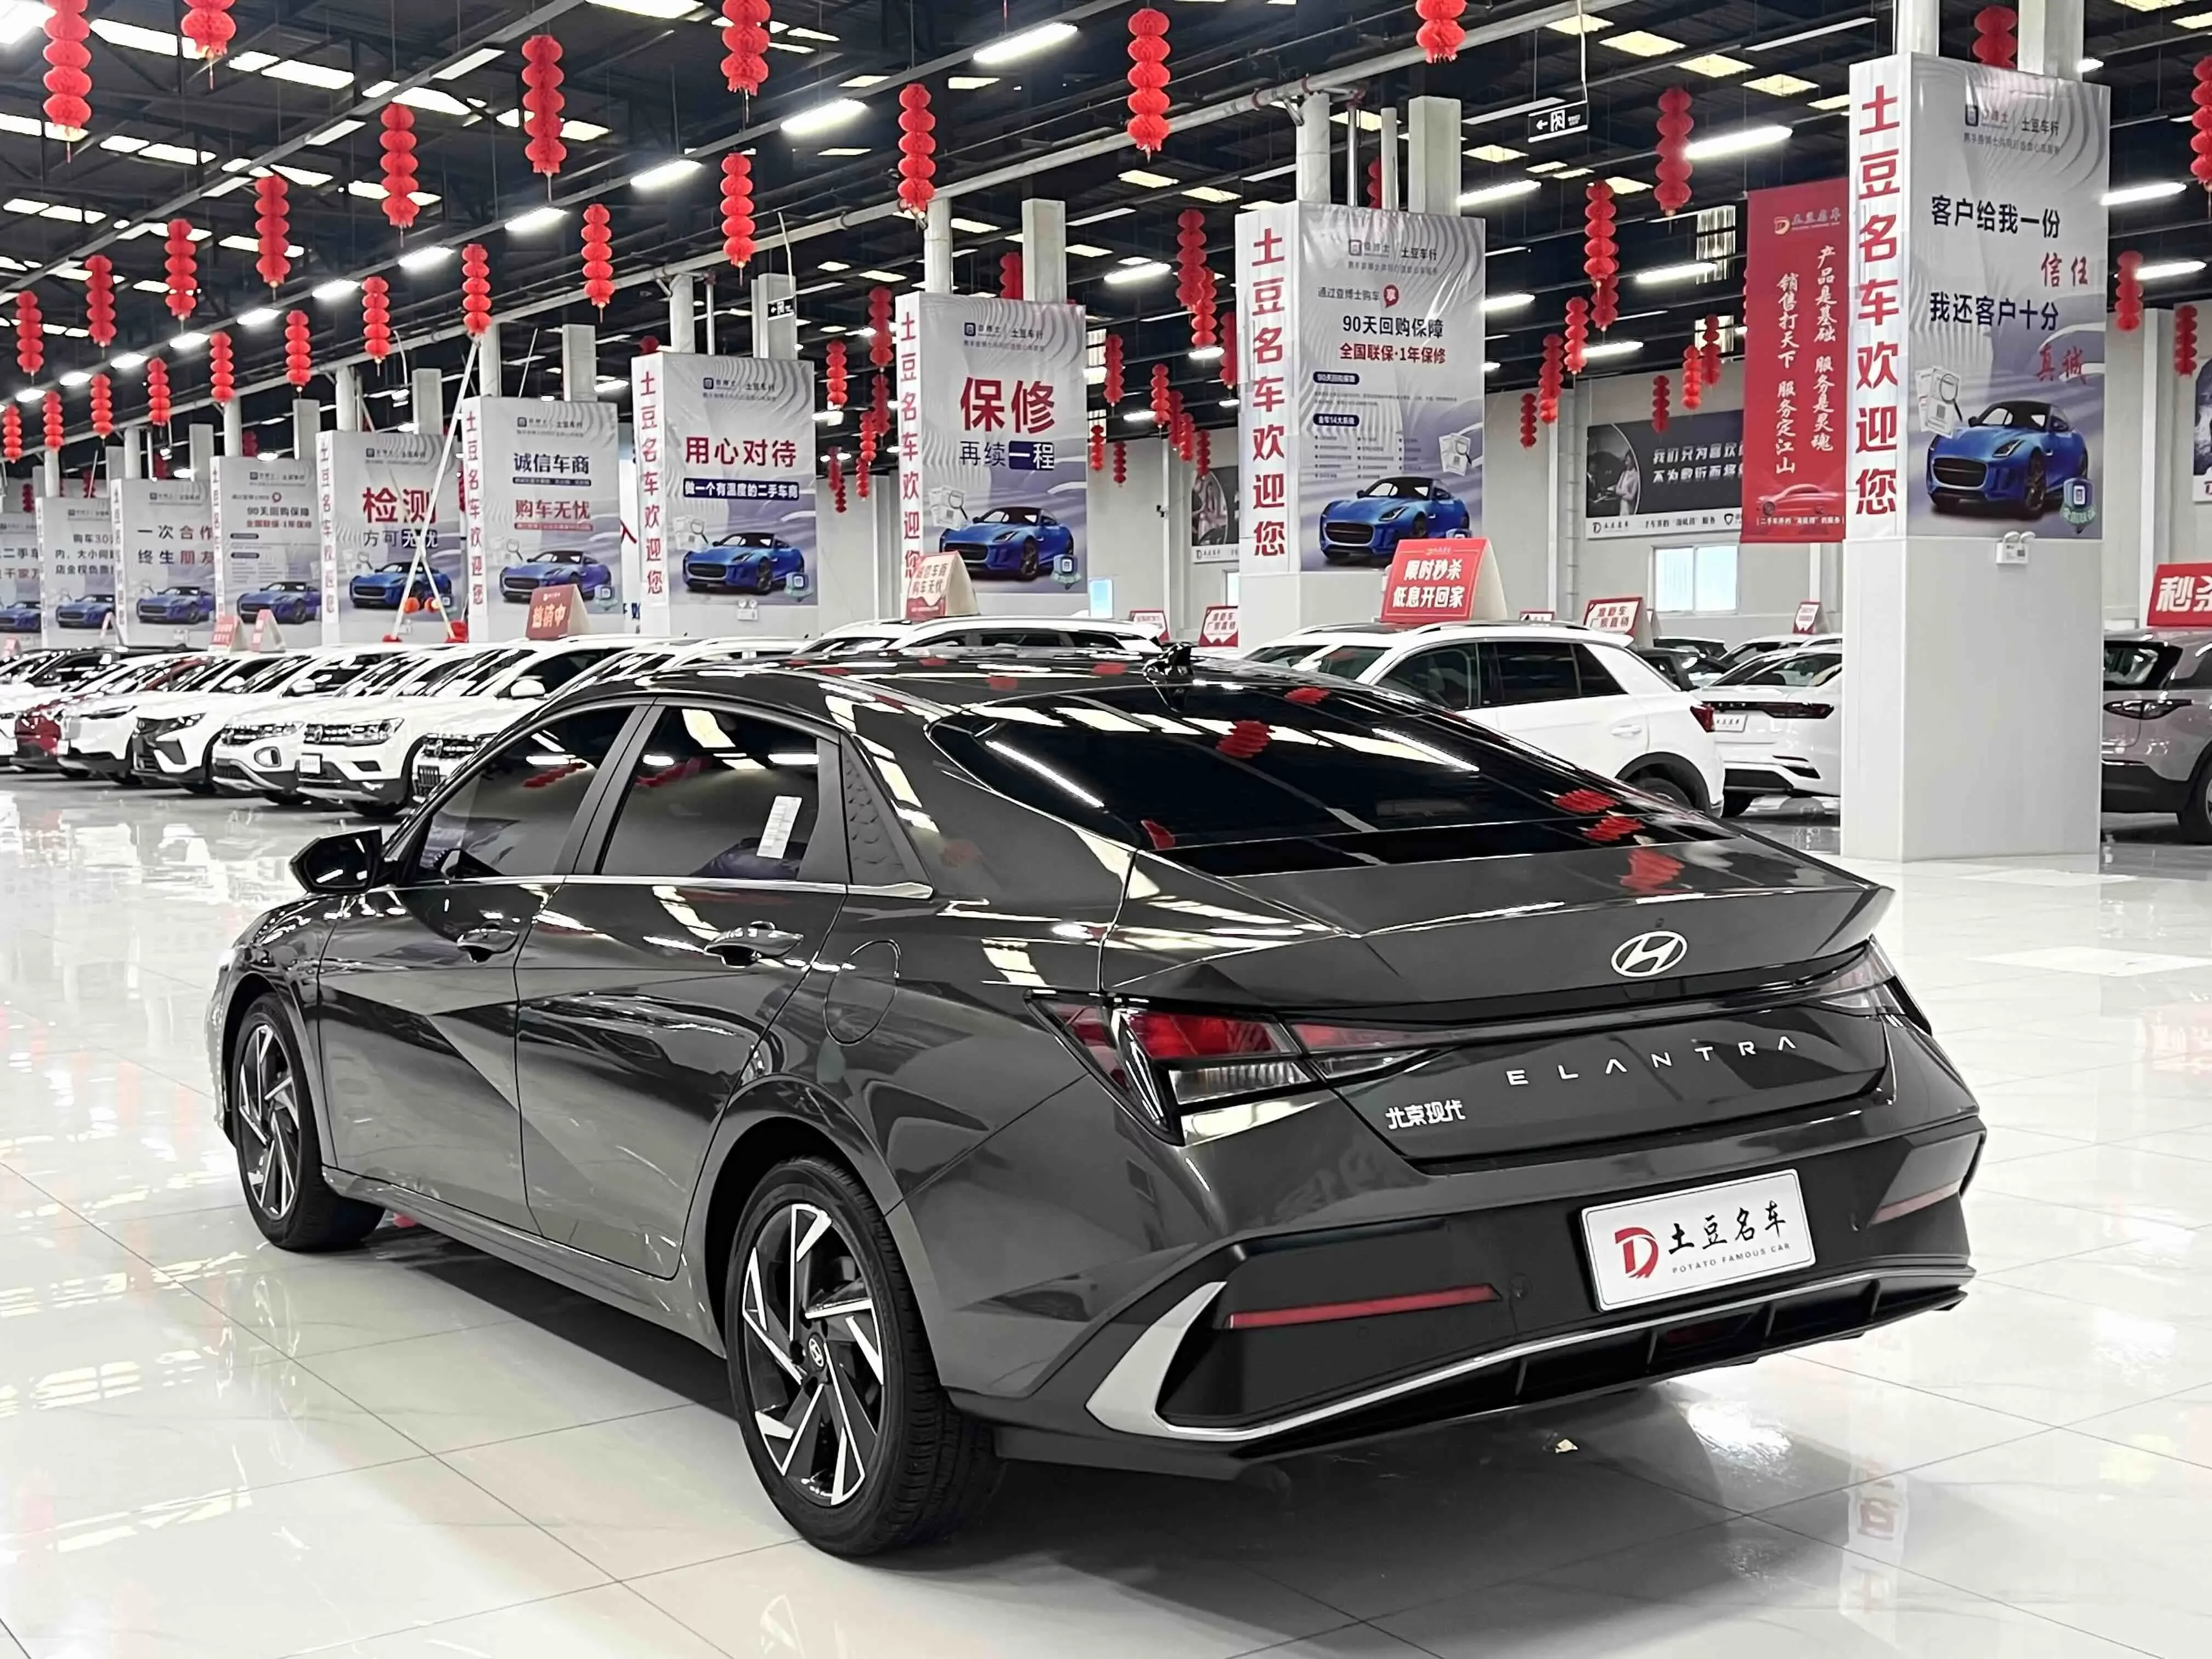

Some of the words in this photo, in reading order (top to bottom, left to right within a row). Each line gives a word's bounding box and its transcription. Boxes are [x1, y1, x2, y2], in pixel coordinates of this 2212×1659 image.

[2021, 117, 2059, 137] 土豆车行
[1931, 195, 2061, 239] 客户给我一份
[1401, 247, 1437, 261] 土豆车行
[2040, 251, 2089, 289] 信任
[1814, 245, 1836, 343] 产品是基础
[1855, 84, 1900, 516] 土豆名车欢迎您
[1930, 292, 2059, 331] 我还客户十分
[1342, 315, 1444, 339] 90天回购保障
[1776, 272, 1799, 369] 销售打天下
[1340, 342, 1446, 364] 全国联保·1年保修
[2035, 344, 2087, 385] 真诚
[960, 376, 1056, 435] 保修
[1251, 228, 1285, 557] 土豆名车欢迎您
[1811, 356, 1836, 452] 服务是灵魂
[900, 311, 921, 579] 土豆名车欢迎您
[1775, 380, 1798, 475] 服务定江山
[514, 452, 589, 475] 诚信车商
[685, 437, 797, 469] 用心对待
[959, 440, 1055, 470] 再续一程
[640, 371, 664, 595] 土豆名车欢迎您
[685, 480, 799, 499] 做一个有温度的二手车商
[363, 487, 437, 524] 检测
[466, 410, 484, 606] 土豆名车欢迎您
[515, 499, 590, 520] 购车无忧
[137, 524, 213, 540] 一次合作
[364, 529, 438, 548] 方可无忧
[138, 549, 214, 566] 终生朋友
[1403, 558, 1463, 581] 限时秒杀
[1392, 585, 1465, 608] 低息开回家
[1505, 1035, 1797, 1086] ELANTRA
[1385, 1099, 1466, 1130] 北京现代
[1668, 1199, 1787, 1255] 土豆名车
[1672, 1259, 1718, 1274] POTATO
[1722, 1247, 1767, 1265] FAMOUS
[1770, 1242, 1791, 1254] CAR
